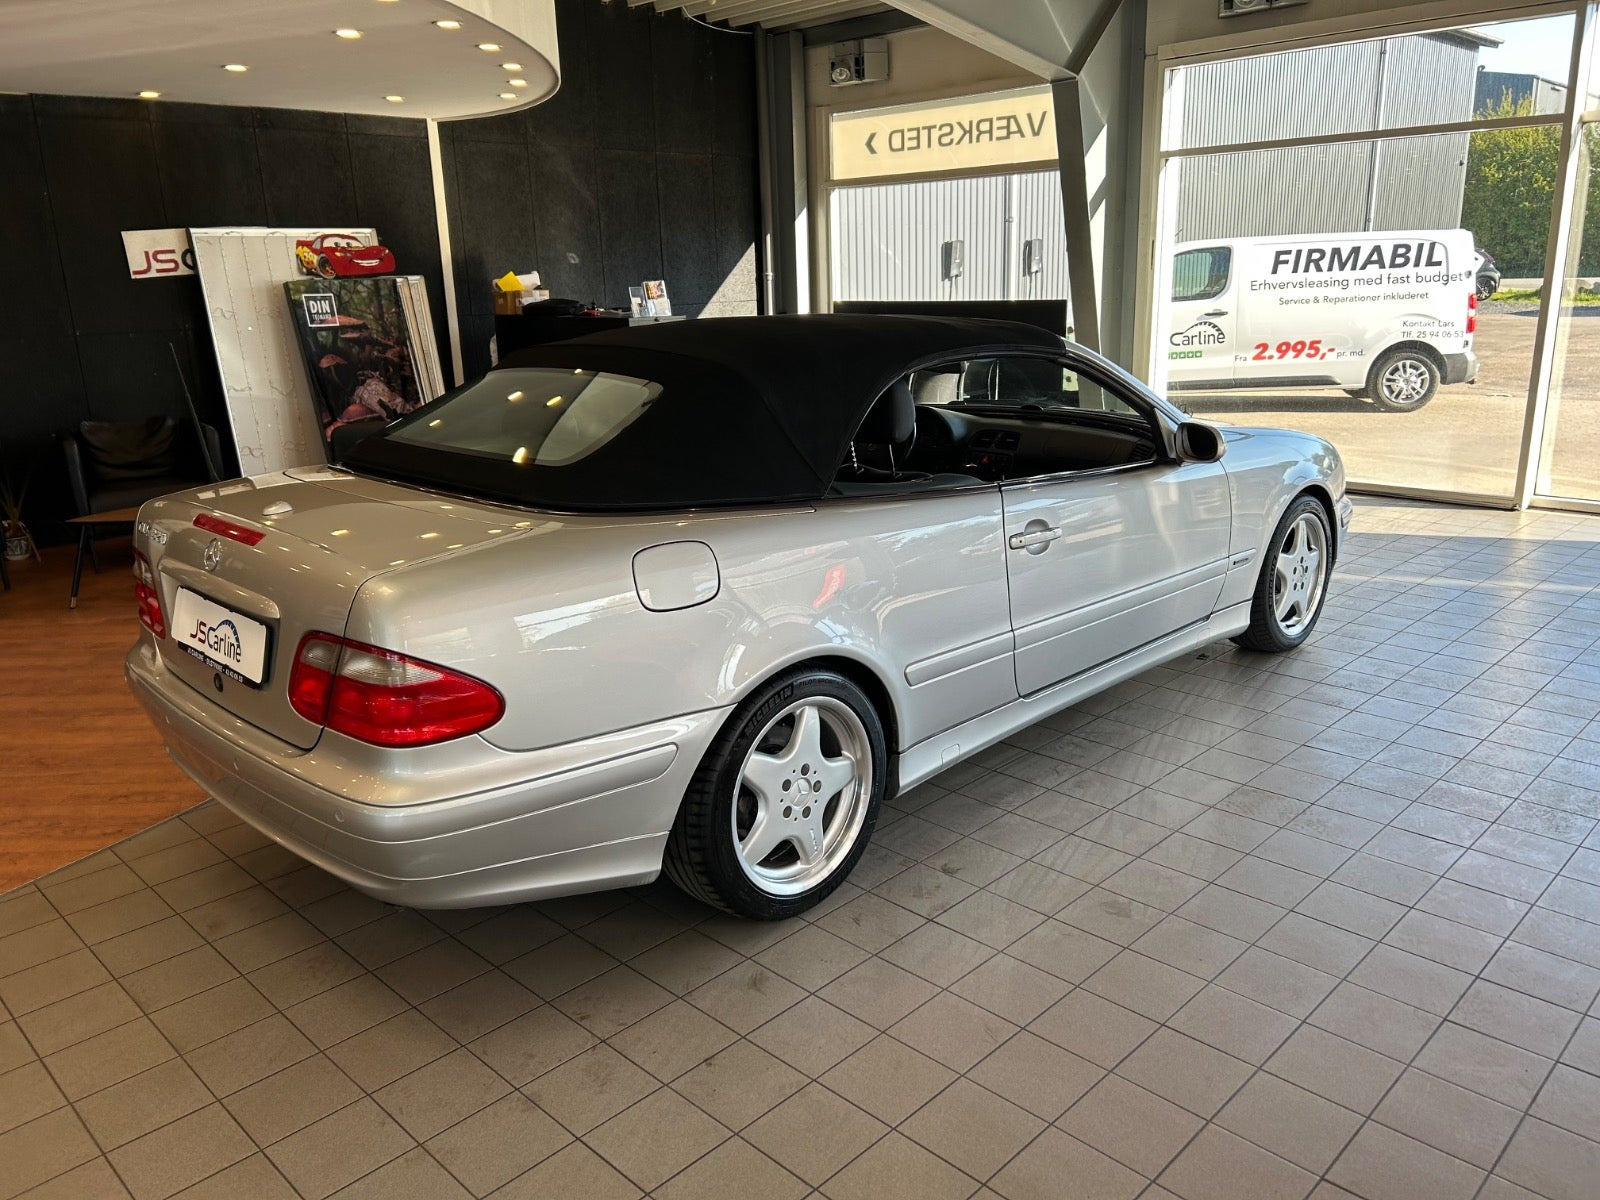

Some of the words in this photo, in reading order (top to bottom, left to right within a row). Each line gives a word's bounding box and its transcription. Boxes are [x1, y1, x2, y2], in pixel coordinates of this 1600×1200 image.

[1271, 241, 1443, 275] FIRMABIL
[1250, 276, 1350, 291] Erhvervsleasing
[1353, 273, 1383, 286] med
[1387, 273, 1411, 285] fast
[1415, 270, 1463, 286] budget
[309, 300, 332, 314] DIN
[1278, 297, 1311, 306] Service
[1312, 296, 1320, 304] &
[1323, 293, 1381, 305] Reparationer
[1383, 291, 1429, 301] inkluderet
[1402, 319, 1435, 328] Kontakt
[1438, 319, 1455, 328] Lars
[1169, 325, 1226, 347] Carline
[1401, 330, 1414, 339] Tlf.
[1416, 330, 1427, 339] 25
[1429, 330, 1440, 338] 94
[1441, 330, 1452, 338] 06
[1454, 330, 1464, 338] 53
[1234, 354, 1248, 362] Fra
[1252, 339, 1336, 361] 2.995,-
[1336, 350, 1347, 360] pr.
[1349, 348, 1366, 357] md.
